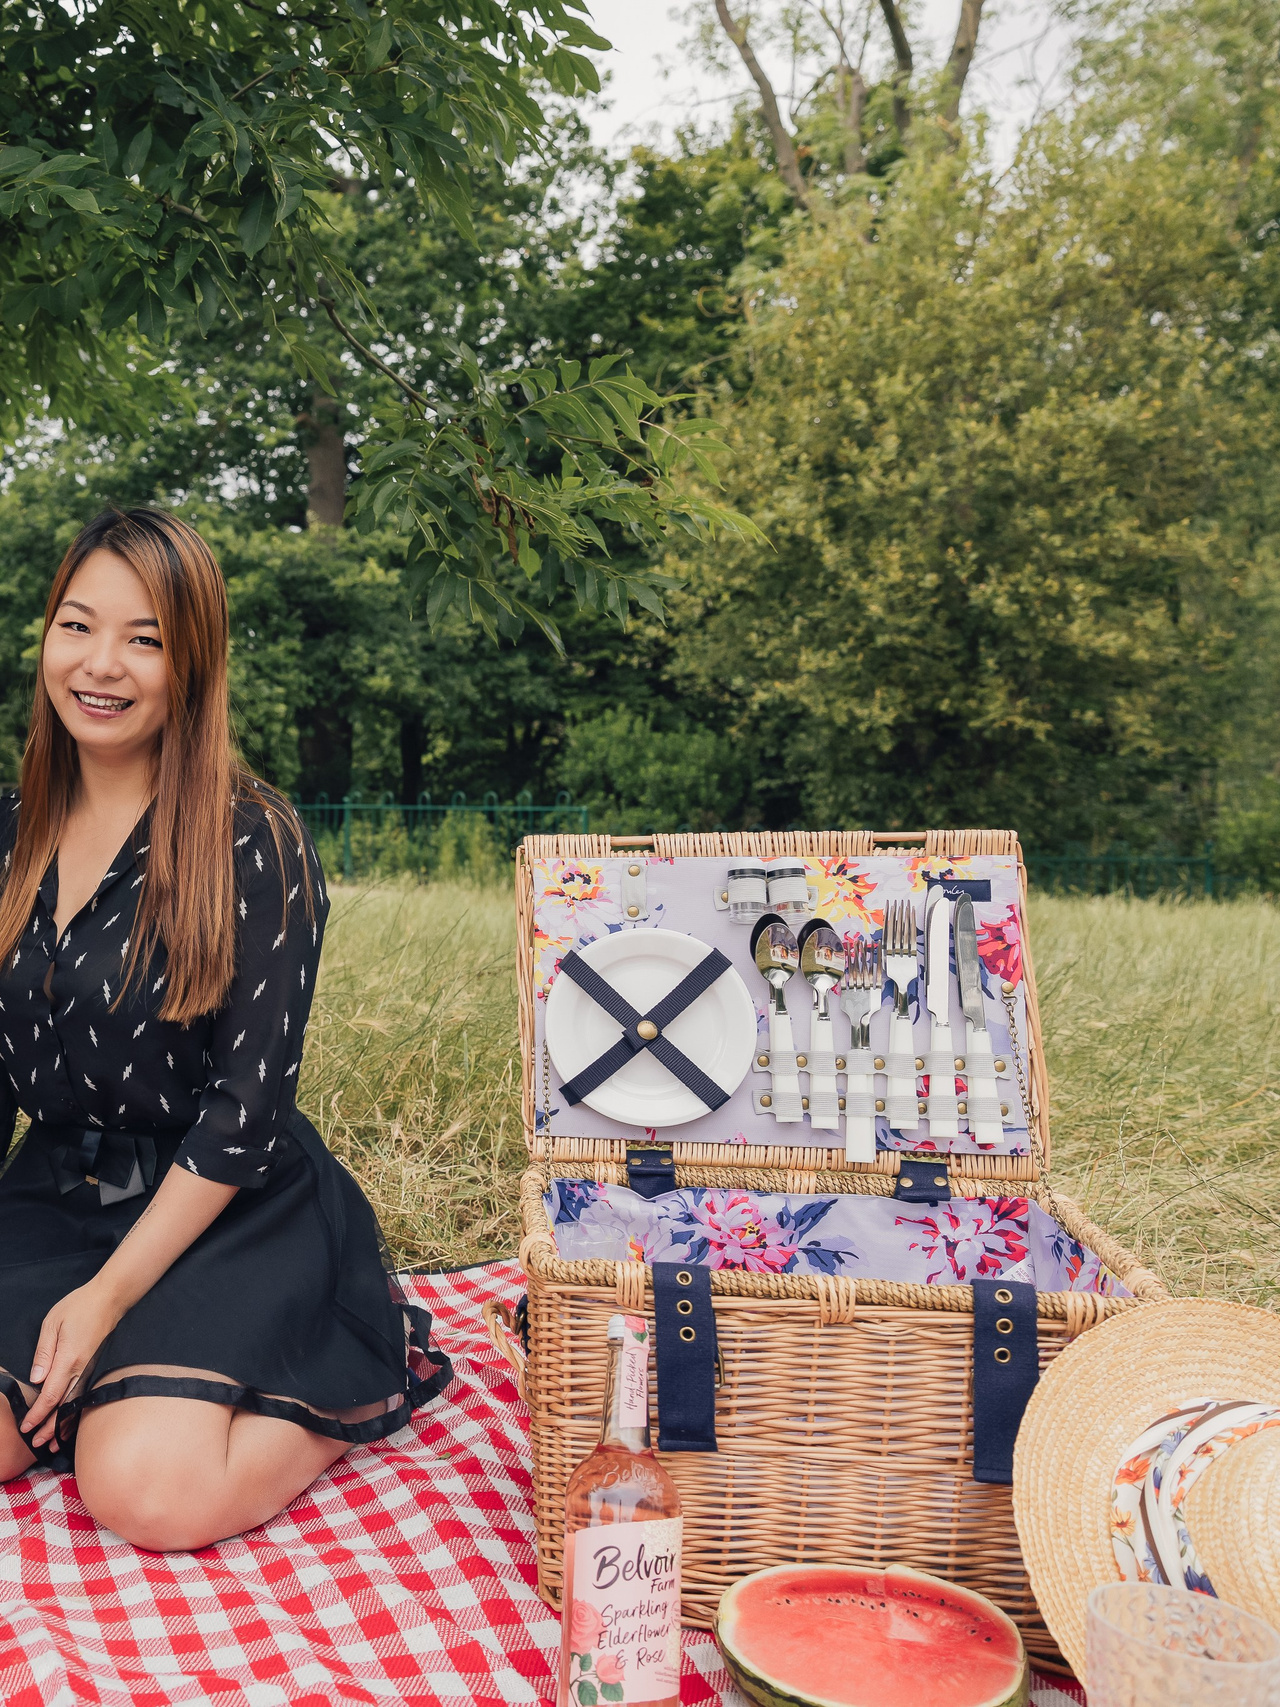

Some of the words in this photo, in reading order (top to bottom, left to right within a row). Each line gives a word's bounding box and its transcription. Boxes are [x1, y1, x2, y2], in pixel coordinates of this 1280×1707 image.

[624, 1351, 638, 1411] Hand-Picked
[636, 1368, 644, 1399] Flowers
[592, 1543, 676, 1590] Belvoir
[651, 1577, 675, 1594] Farm
[601, 1599, 668, 1628] Sparkling
[598, 1623, 671, 1650] Elderflower
[615, 1649, 628, 1670] &
[636, 1647, 666, 1670] Rose
